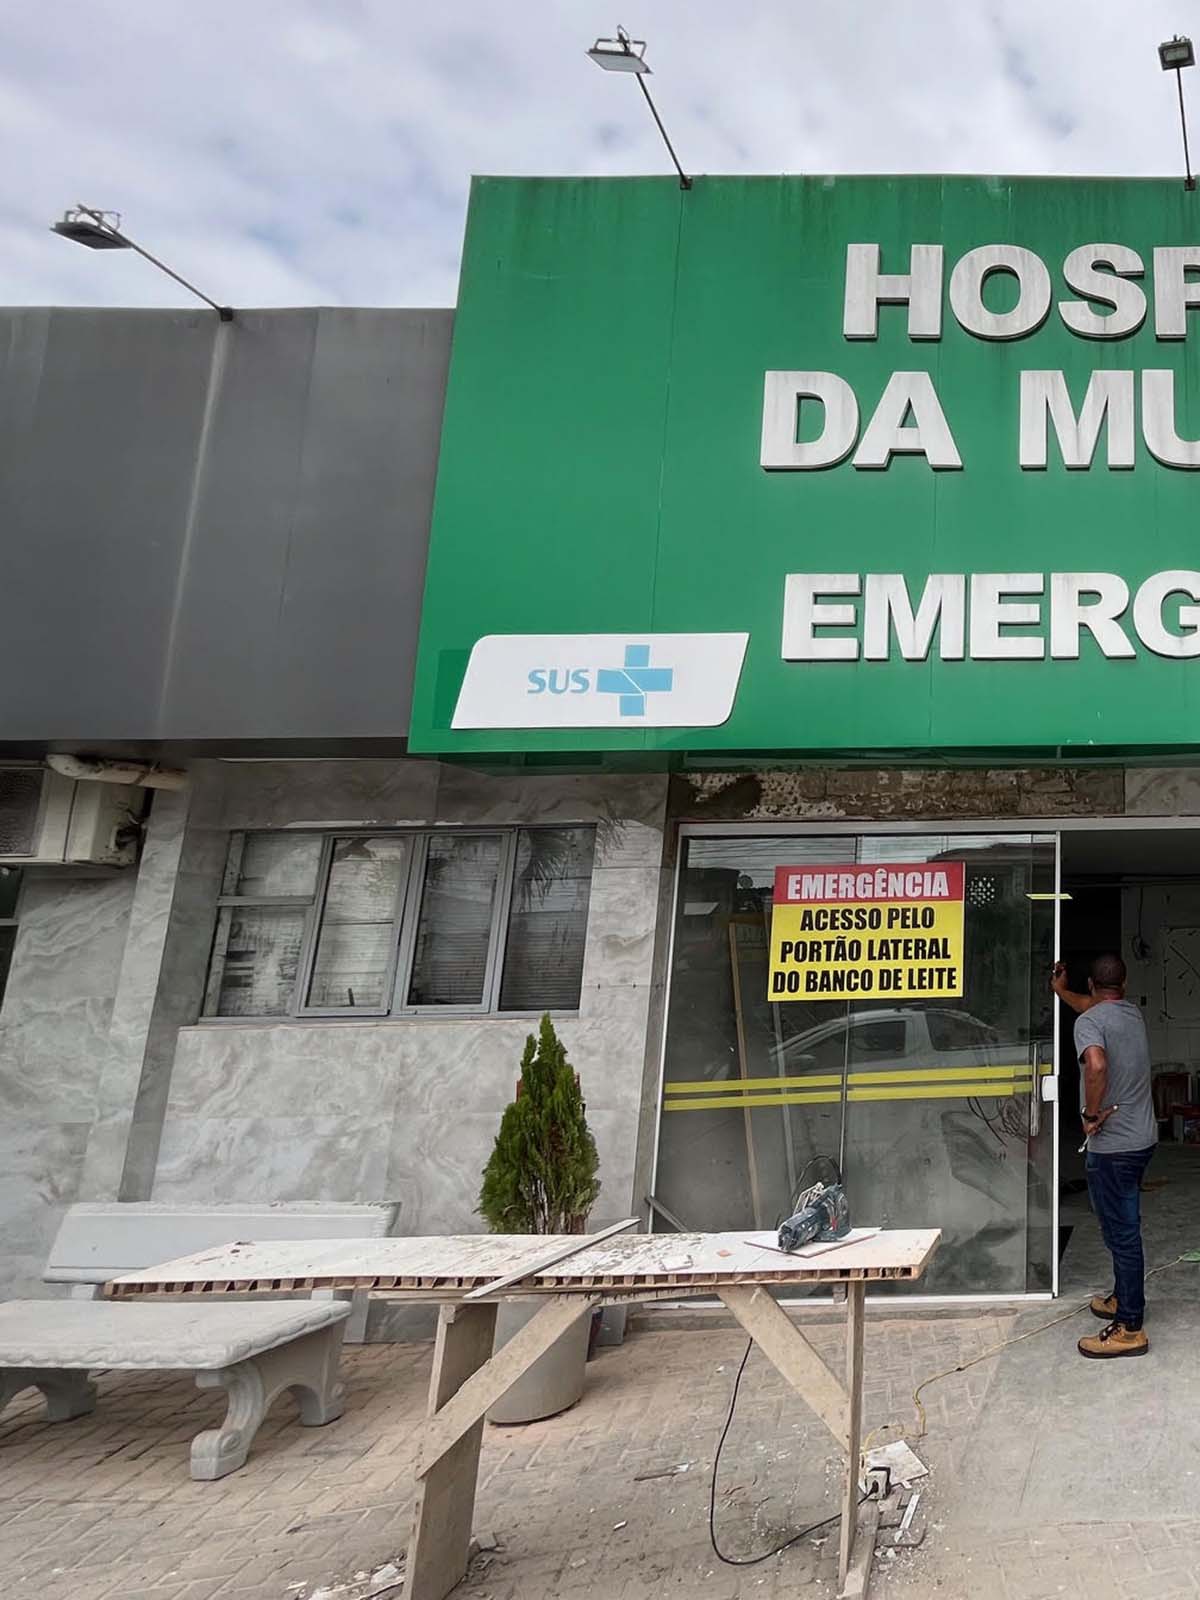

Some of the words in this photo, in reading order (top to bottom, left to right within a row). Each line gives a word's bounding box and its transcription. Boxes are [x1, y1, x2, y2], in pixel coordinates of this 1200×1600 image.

[760, 369, 963, 470] DA
[527, 668, 590, 695] SUS
[787, 868, 949, 900] EMERGÊNCIA
[800, 907, 881, 931] ACESSO
[887, 907, 935, 929] PELO
[780, 935, 862, 963] PORTÃO
[867, 938, 951, 961] LATERAL
[772, 970, 800, 993] DO
[805, 968, 873, 992] BANCO
[878, 968, 902, 991] DE
[907, 967, 957, 990] LEITE
